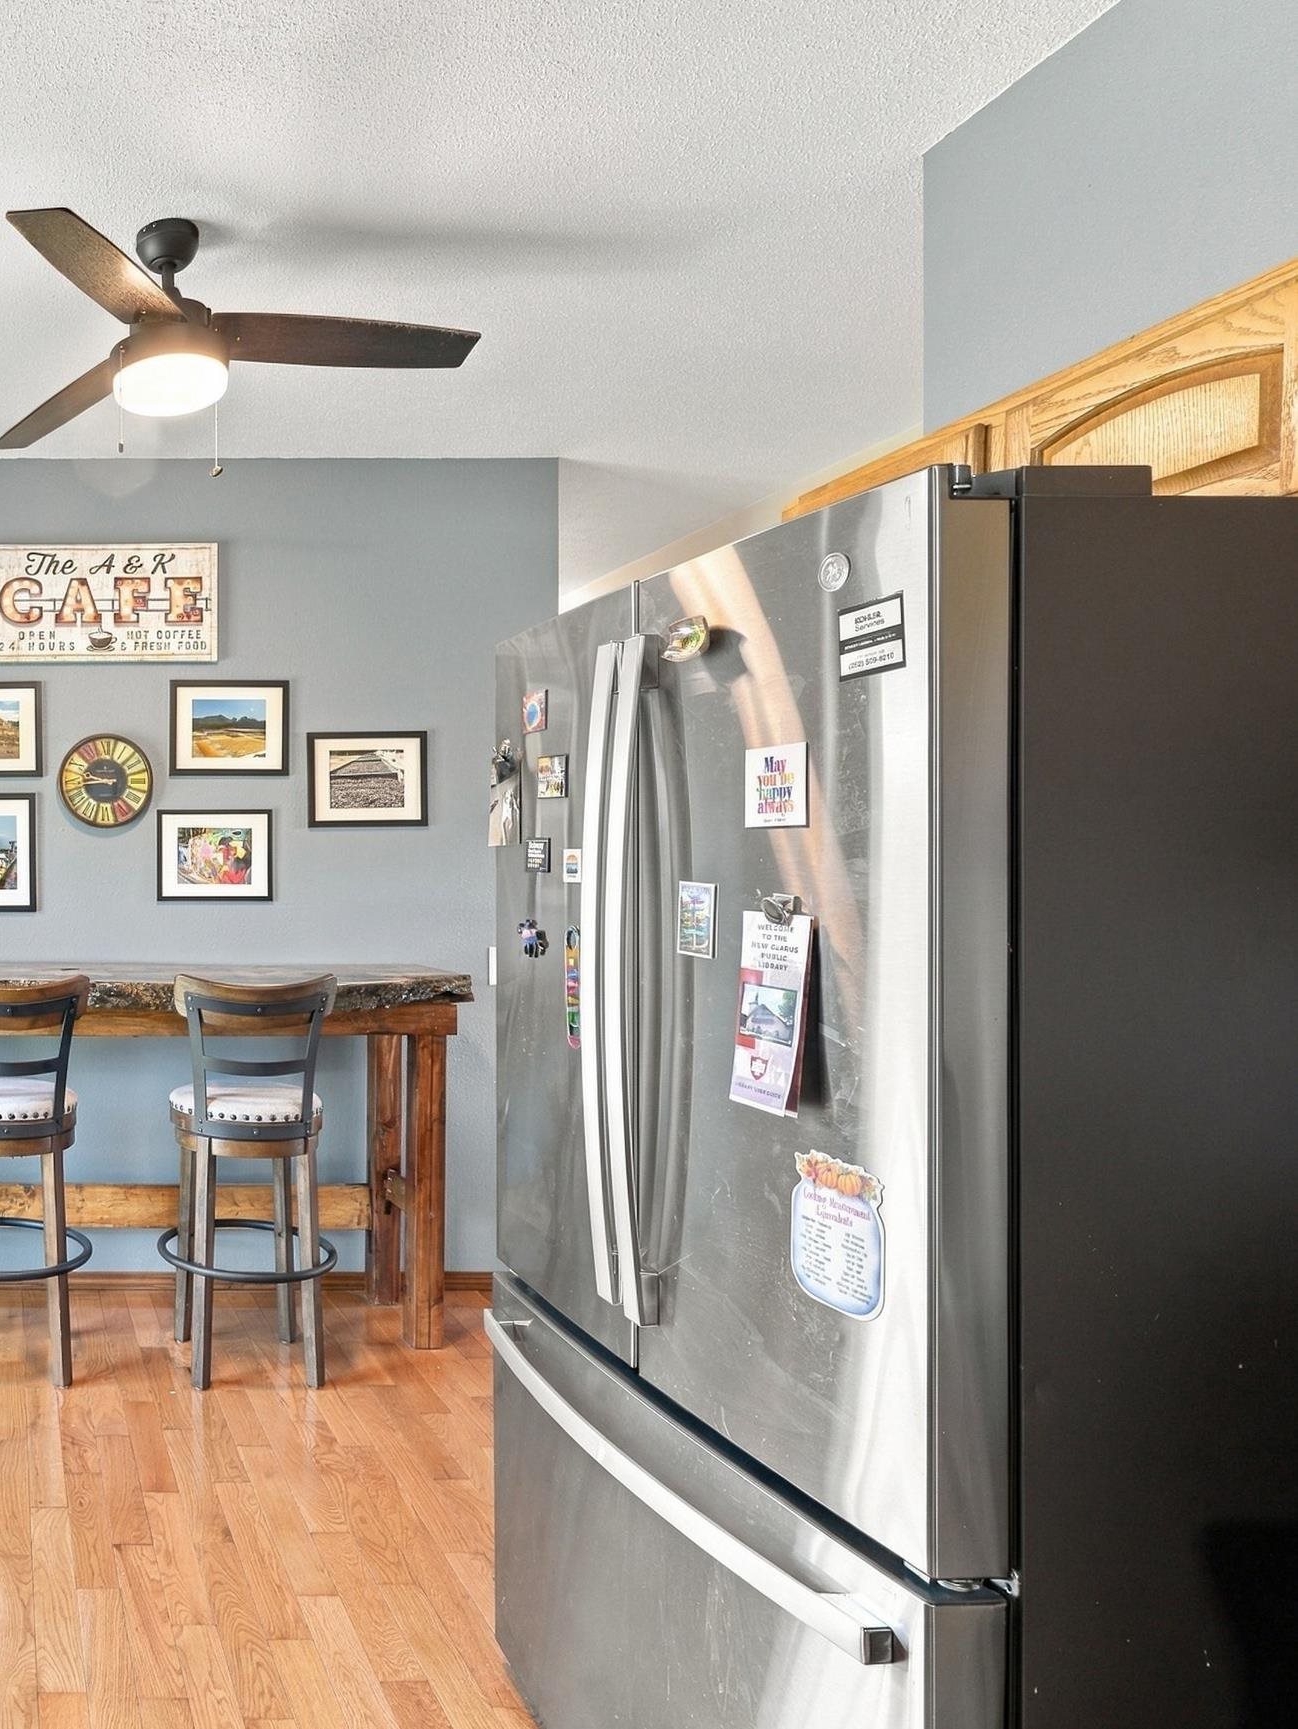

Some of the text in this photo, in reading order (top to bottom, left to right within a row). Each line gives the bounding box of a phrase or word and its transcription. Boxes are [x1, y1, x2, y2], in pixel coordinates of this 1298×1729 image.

[25, 552, 176, 576] The A & K
[855, 619, 886, 633] Services
[18, 630, 57, 641] OPEN
[127, 629, 203, 640] HOT COFFEE
[28, 641, 77, 652] HOURS
[133, 641, 172, 652] FRESH
[177, 640, 208, 651] FOOD
[764, 756, 788, 776] May
[757, 771, 795, 790] you be
[756, 785, 793, 803] happy
[757, 798, 795, 817] always
[757, 923, 795, 933] WELCOME
[774, 934, 788, 942] THE
[751, 941, 769, 950] NEW
[761, 952, 788, 961] PUBLIC
[758, 961, 789, 971] LIBRARY
